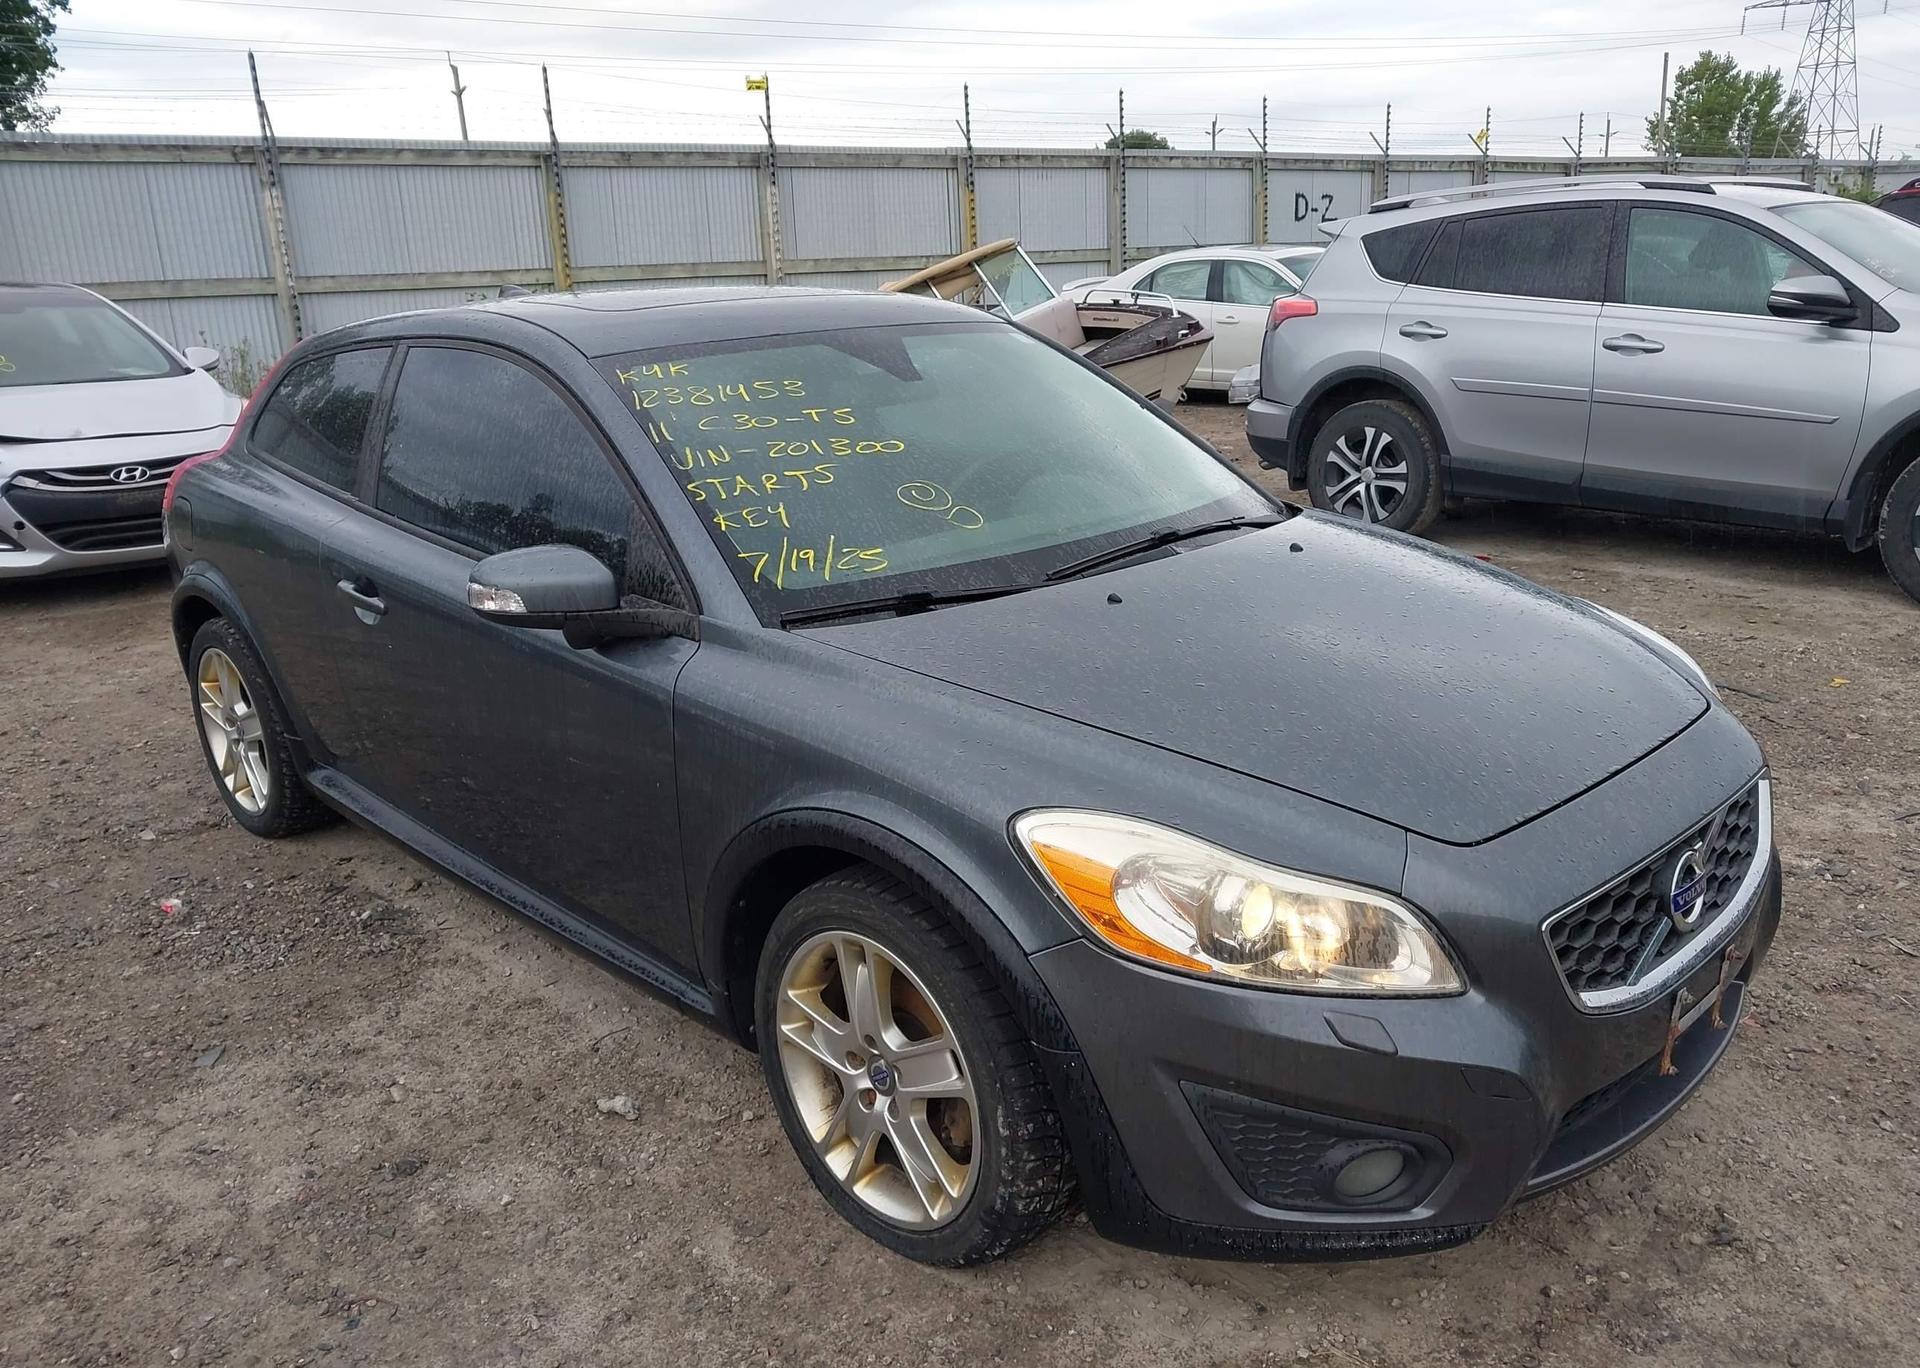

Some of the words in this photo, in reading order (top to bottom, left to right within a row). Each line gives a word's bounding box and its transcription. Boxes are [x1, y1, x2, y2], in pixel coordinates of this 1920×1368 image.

[632, 380, 805, 409] 12381453
[687, 463, 840, 501] STARTS
[738, 536, 888, 589] 7/19/25
